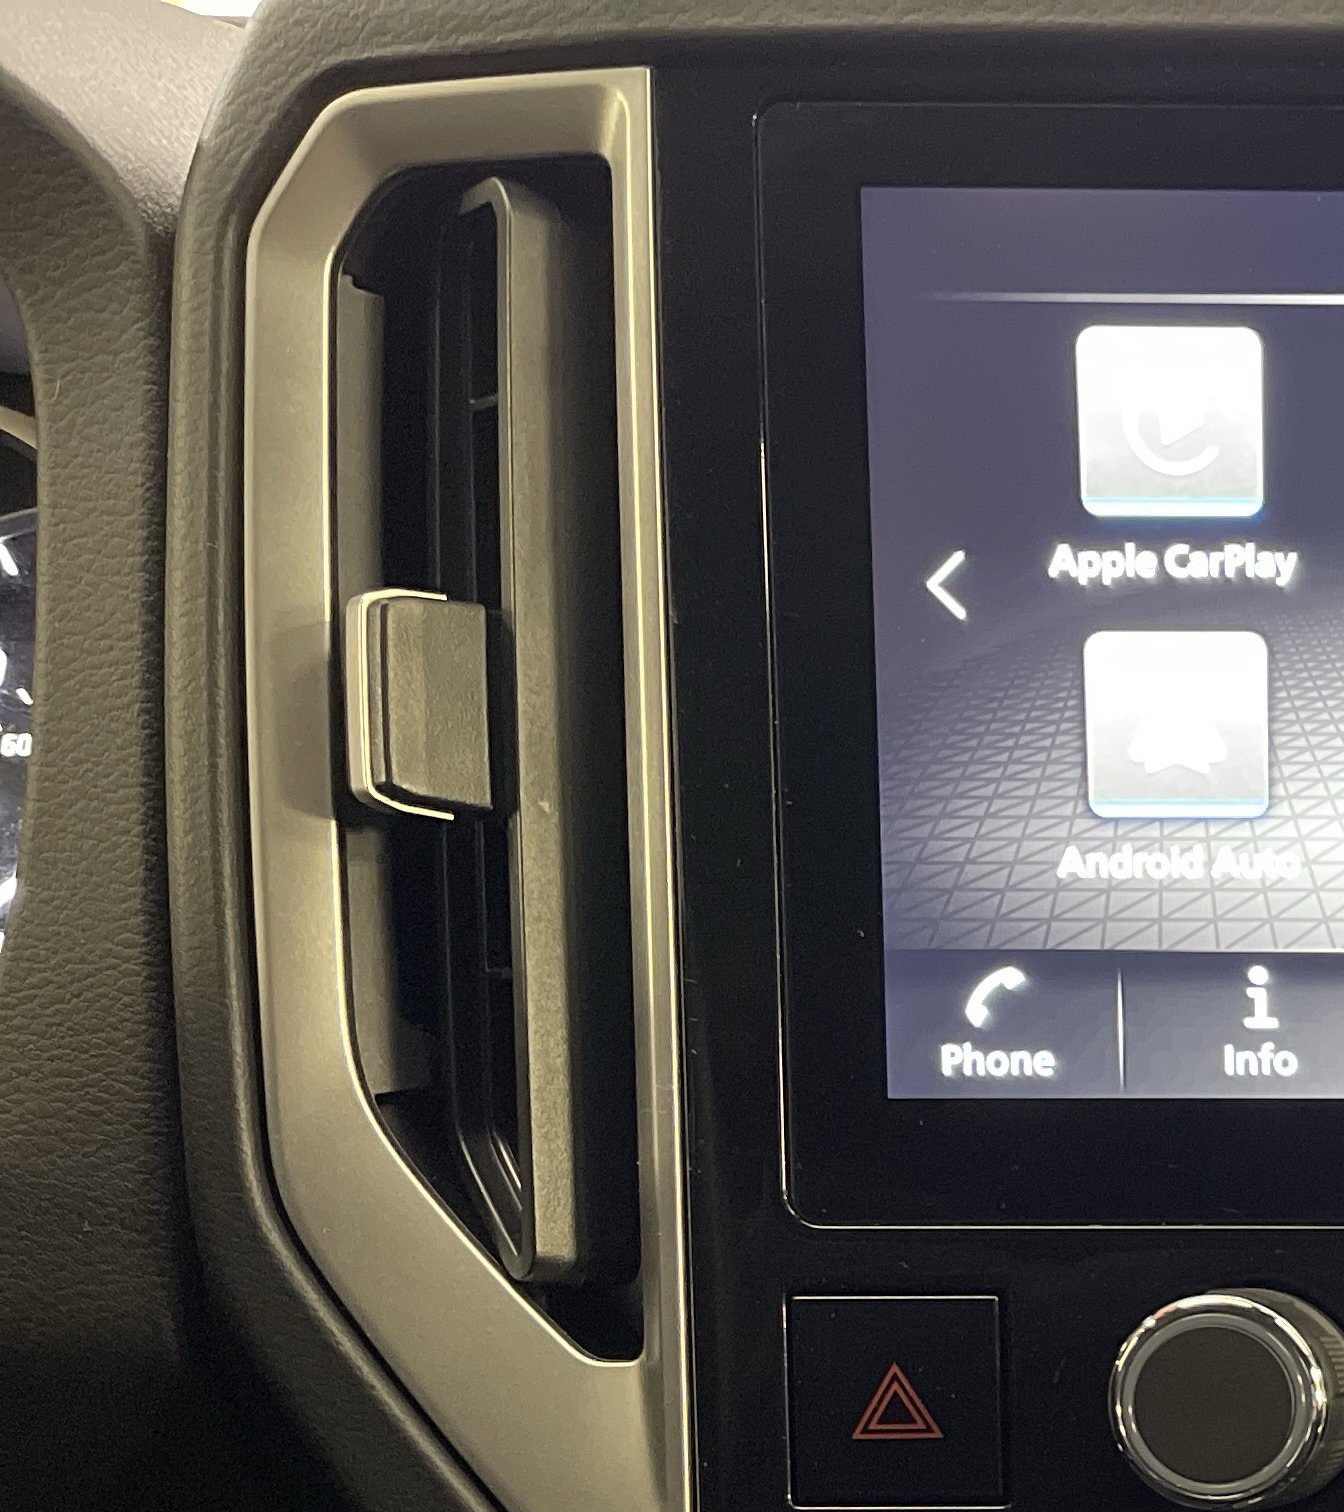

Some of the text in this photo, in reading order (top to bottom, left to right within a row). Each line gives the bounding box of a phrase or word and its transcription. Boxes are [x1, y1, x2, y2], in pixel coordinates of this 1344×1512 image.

[1047, 543, 1300, 588] Apple CarPlay
[1056, 842, 1302, 880] Android Auto
[940, 1044, 1056, 1080] Phone
[1223, 1042, 1299, 1080] Info
